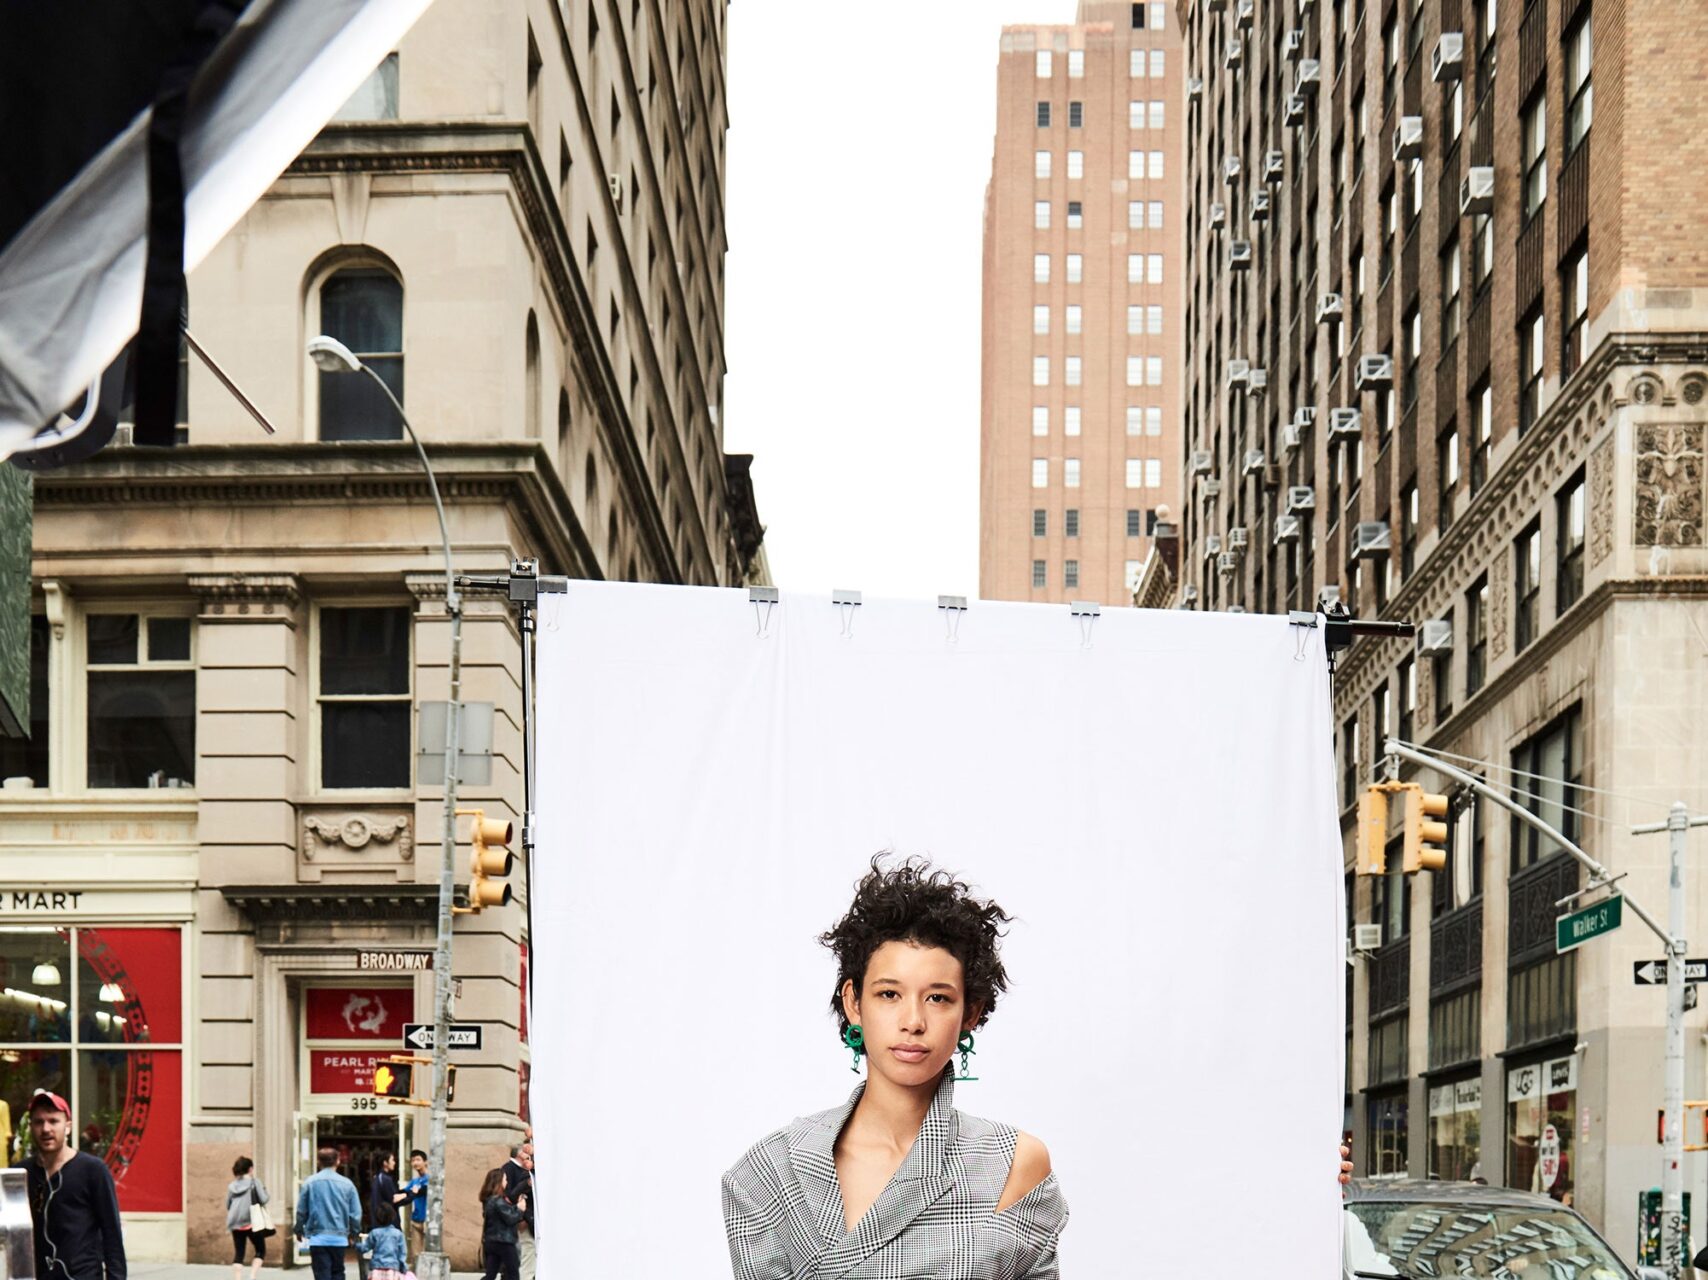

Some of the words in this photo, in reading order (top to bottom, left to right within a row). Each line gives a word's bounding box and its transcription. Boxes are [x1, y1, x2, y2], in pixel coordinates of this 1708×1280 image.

[12, 891, 83, 909] MART
[1572, 914, 1598, 938] Walker
[1600, 908, 1608, 928] St
[360, 953, 429, 969] BROADWAY
[1654, 966, 1667, 977] ON
[1684, 966, 1702, 977] AY
[418, 1032, 434, 1042] ON
[323, 1057, 365, 1067] PEARL
[351, 1097, 377, 1110] 395
